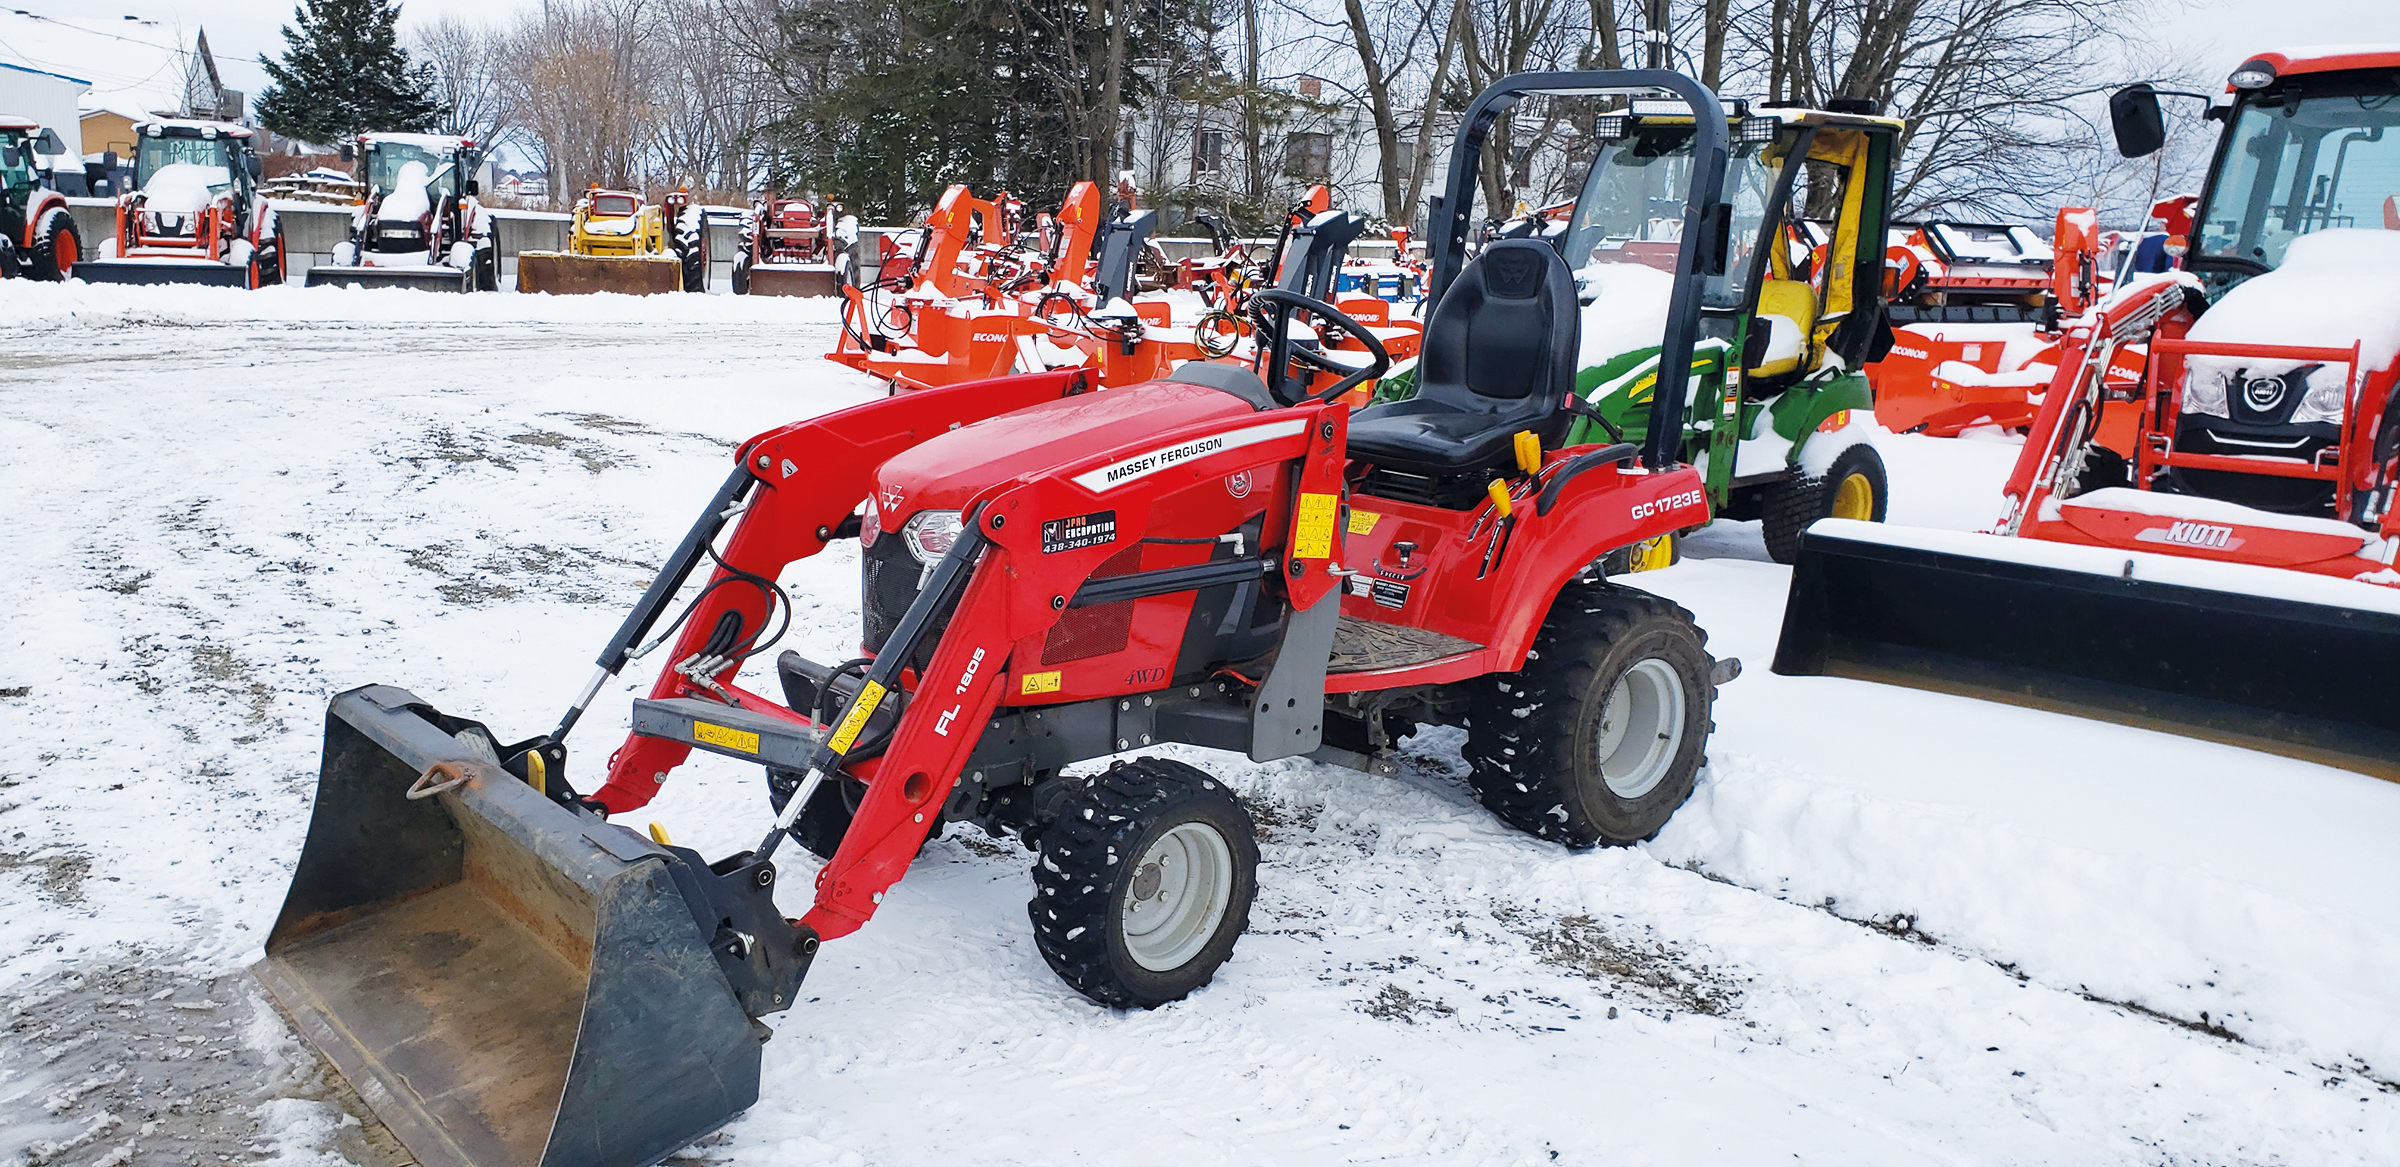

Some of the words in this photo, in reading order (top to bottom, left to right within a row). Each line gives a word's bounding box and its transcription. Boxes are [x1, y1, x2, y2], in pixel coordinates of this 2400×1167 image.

[1304, 273, 1314, 297] TEOR
[1107, 456, 1157, 482] MASSEY
[1161, 438, 1223, 464] FERGUSON
[1043, 533, 1116, 553] 438-340-1974
[2165, 521, 2235, 548] KIOTI
[1124, 667, 1165, 685] 4WD
[934, 704, 961, 737] FL
[956, 646, 985, 695] 1805
